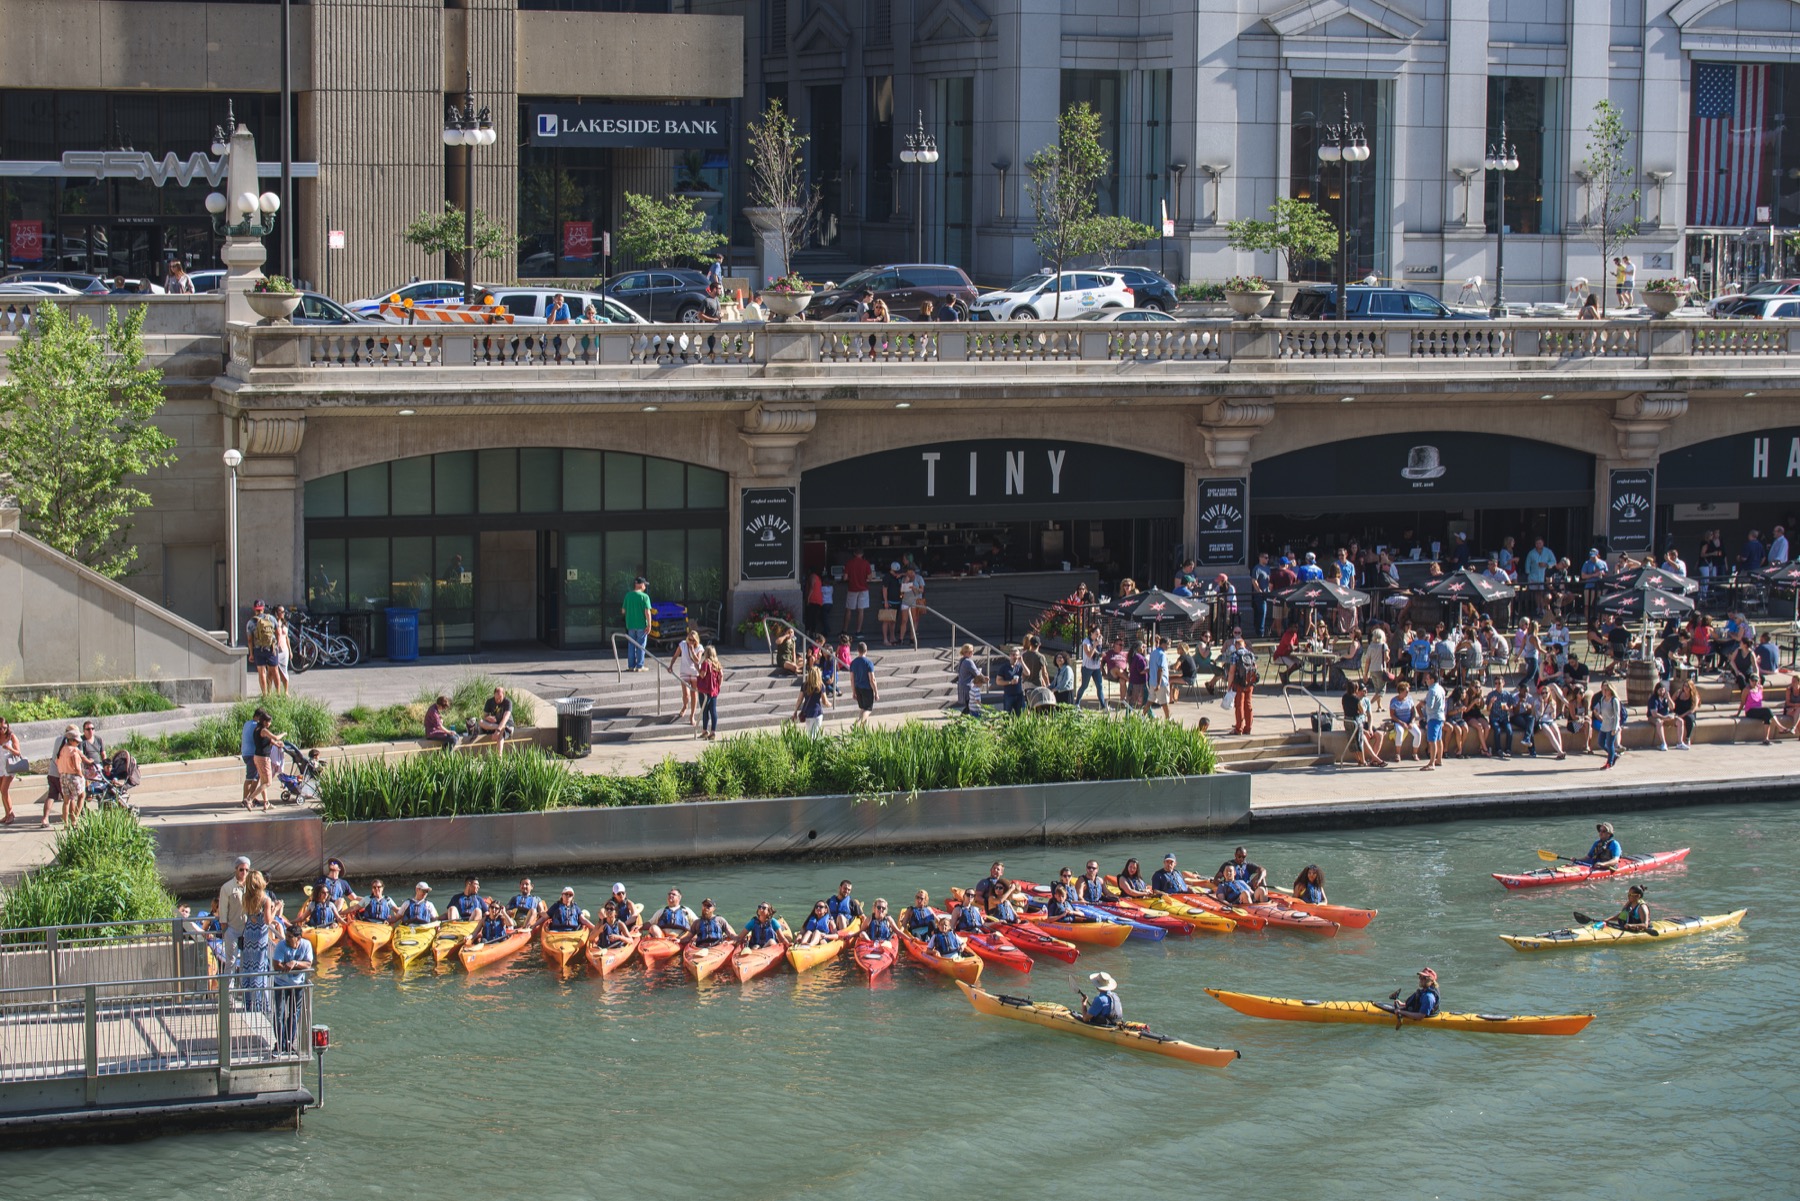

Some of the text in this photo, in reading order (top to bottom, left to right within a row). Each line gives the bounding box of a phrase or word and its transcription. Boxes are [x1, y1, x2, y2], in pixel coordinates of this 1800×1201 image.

[1699, 36, 1713, 49] 77
[1721, 36, 1760, 51] WEST
[562, 119, 718, 135] LAKESIDE BANK
[922, 450, 1066, 497] TINY
[1612, 493, 1650, 512] TINY HATT
[1201, 503, 1242, 523] TINY HATT
[745, 514, 791, 534] TINY HATT
